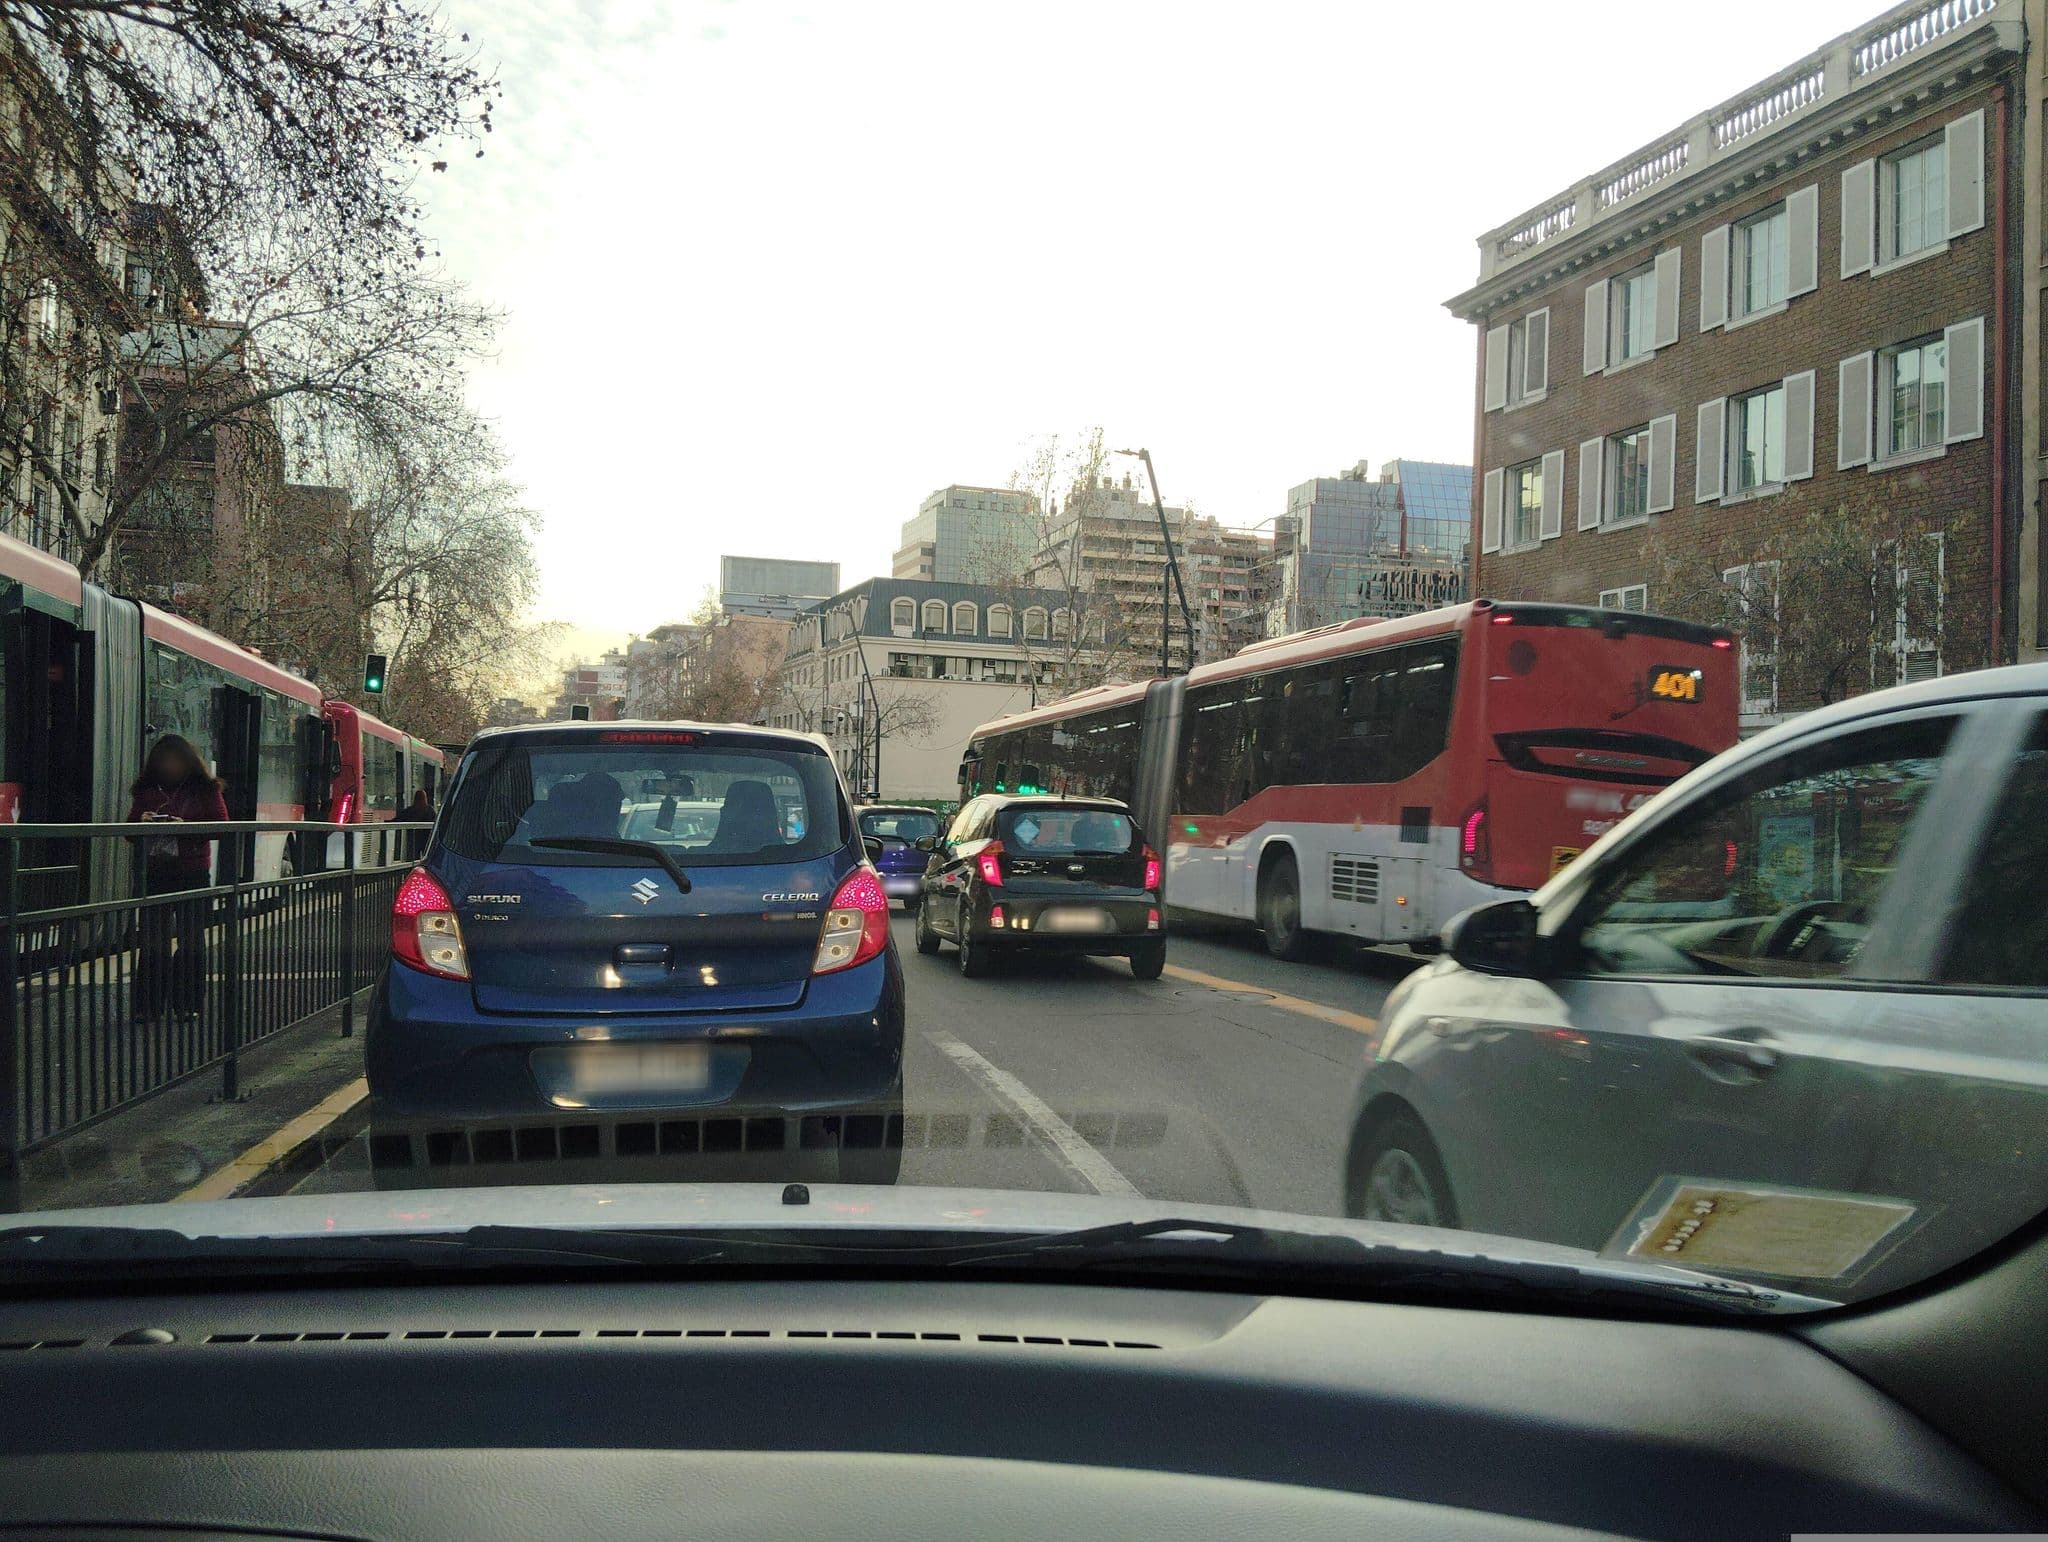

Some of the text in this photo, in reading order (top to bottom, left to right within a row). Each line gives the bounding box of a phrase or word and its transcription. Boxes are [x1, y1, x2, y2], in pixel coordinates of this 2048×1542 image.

[1652, 671, 1696, 699] 401
[466, 894, 522, 904] SUZUKI
[762, 892, 819, 902] CELERIO
